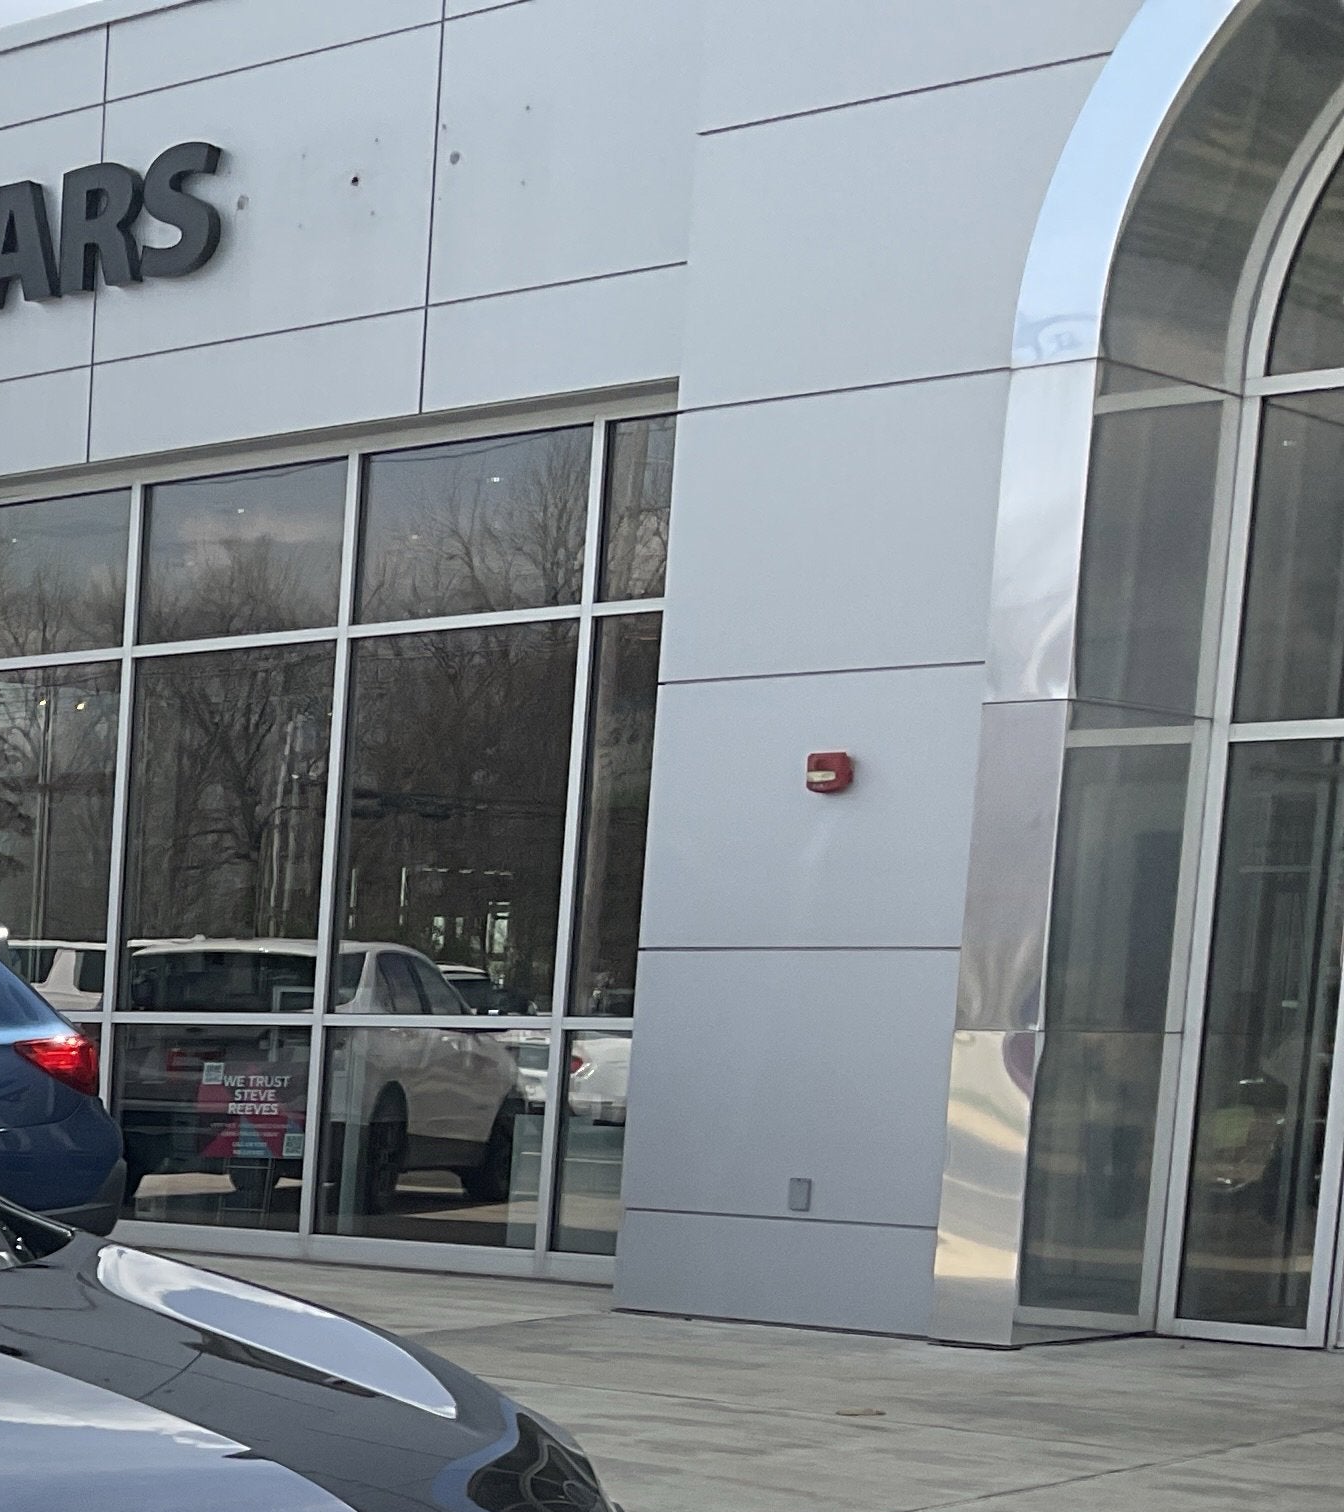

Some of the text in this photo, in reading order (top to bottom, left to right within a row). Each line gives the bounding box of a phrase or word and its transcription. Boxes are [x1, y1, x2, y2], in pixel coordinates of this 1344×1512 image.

[224, 1075, 290, 1088] WE TRUST
[234, 1089, 276, 1101] STEVE
[227, 1102, 278, 1115] REEVES
